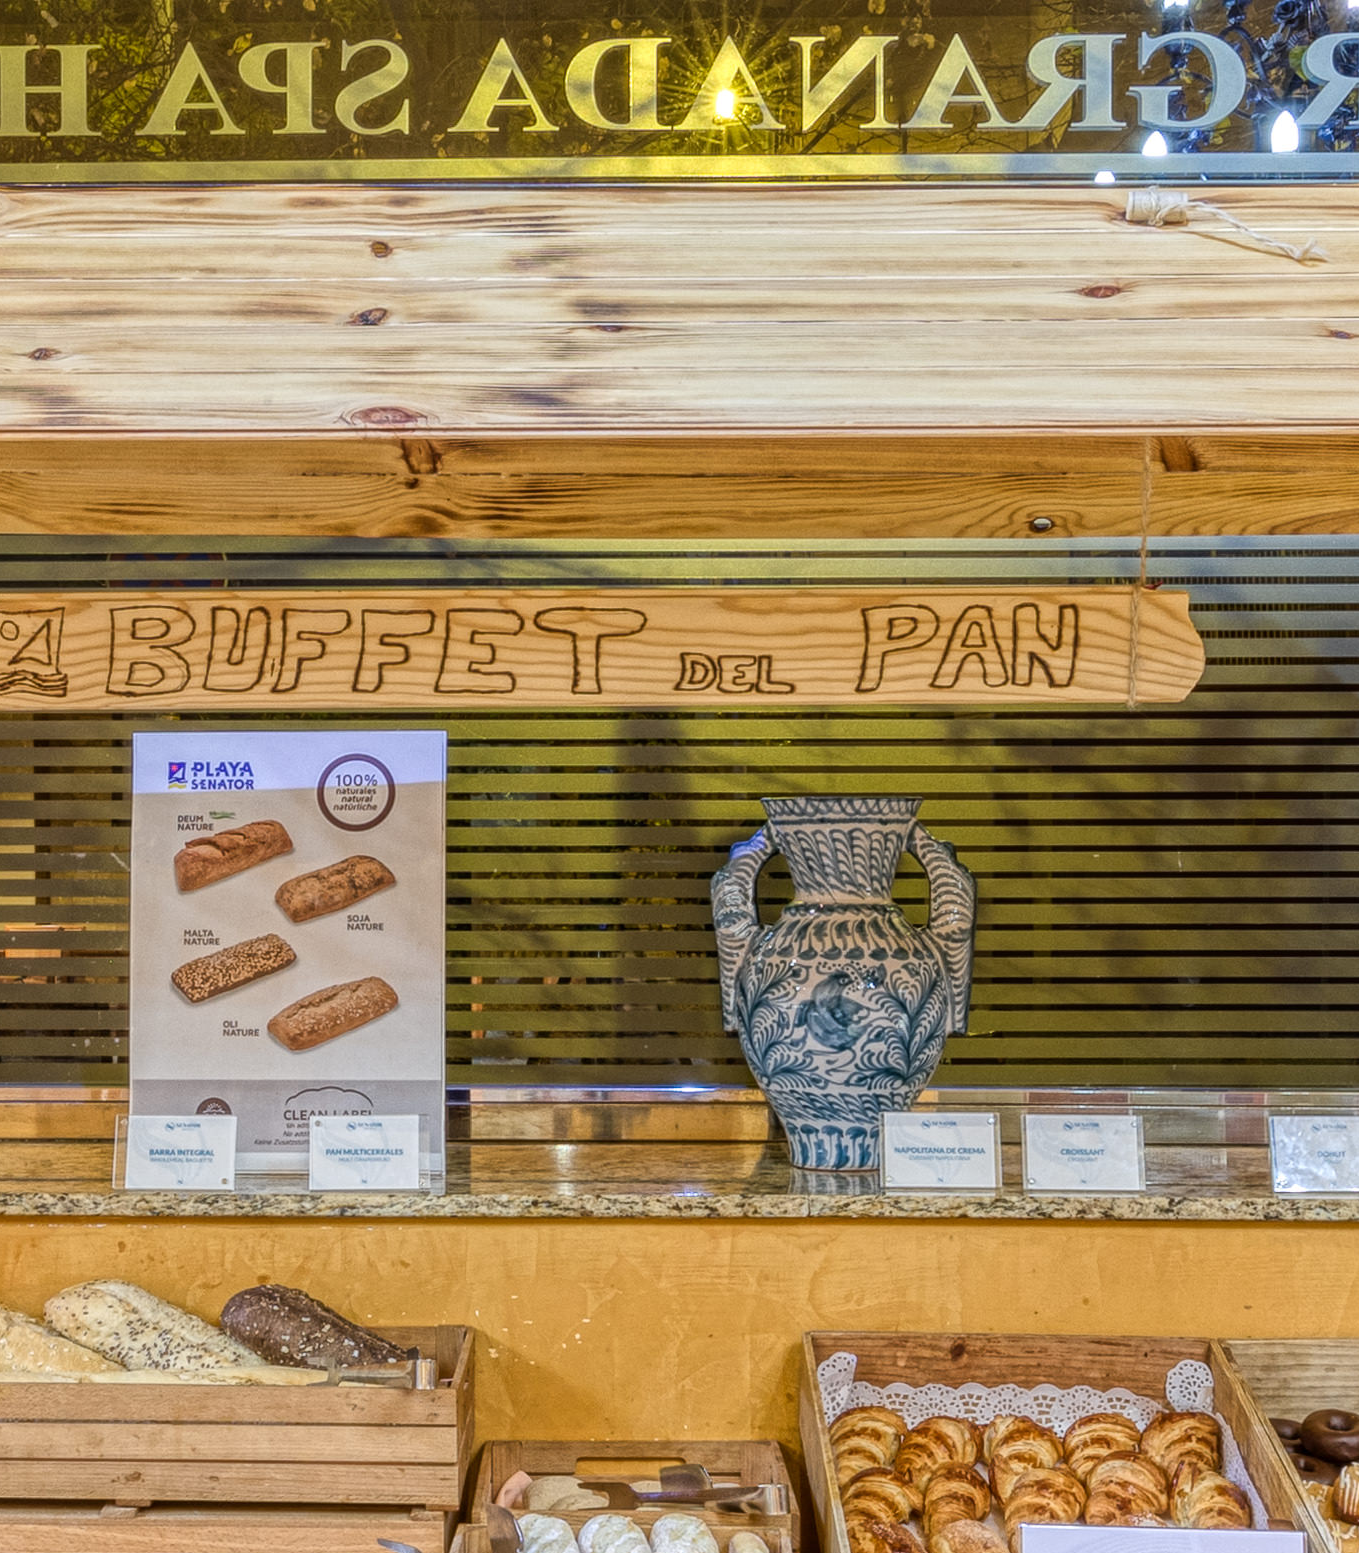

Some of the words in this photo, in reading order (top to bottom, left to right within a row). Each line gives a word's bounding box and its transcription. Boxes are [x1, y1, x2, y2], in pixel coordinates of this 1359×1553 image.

[105, 606, 649, 697] BUFFET
[674, 654, 797, 697] DEL
[857, 603, 1081, 692] PAN
[191, 761, 254, 777] PLAYA
[192, 779, 254, 790] SENATOR
[336, 774, 378, 787] 100%
[336, 787, 376, 795] naturales
[341, 794, 373, 803] natural
[177, 823, 214, 831] NATURE
[347, 915, 371, 923] SOJA
[347, 923, 384, 931] NATURE
[183, 929, 214, 937] MALTA
[183, 937, 220, 946] NATURE
[222, 1029, 260, 1037] NATURE
